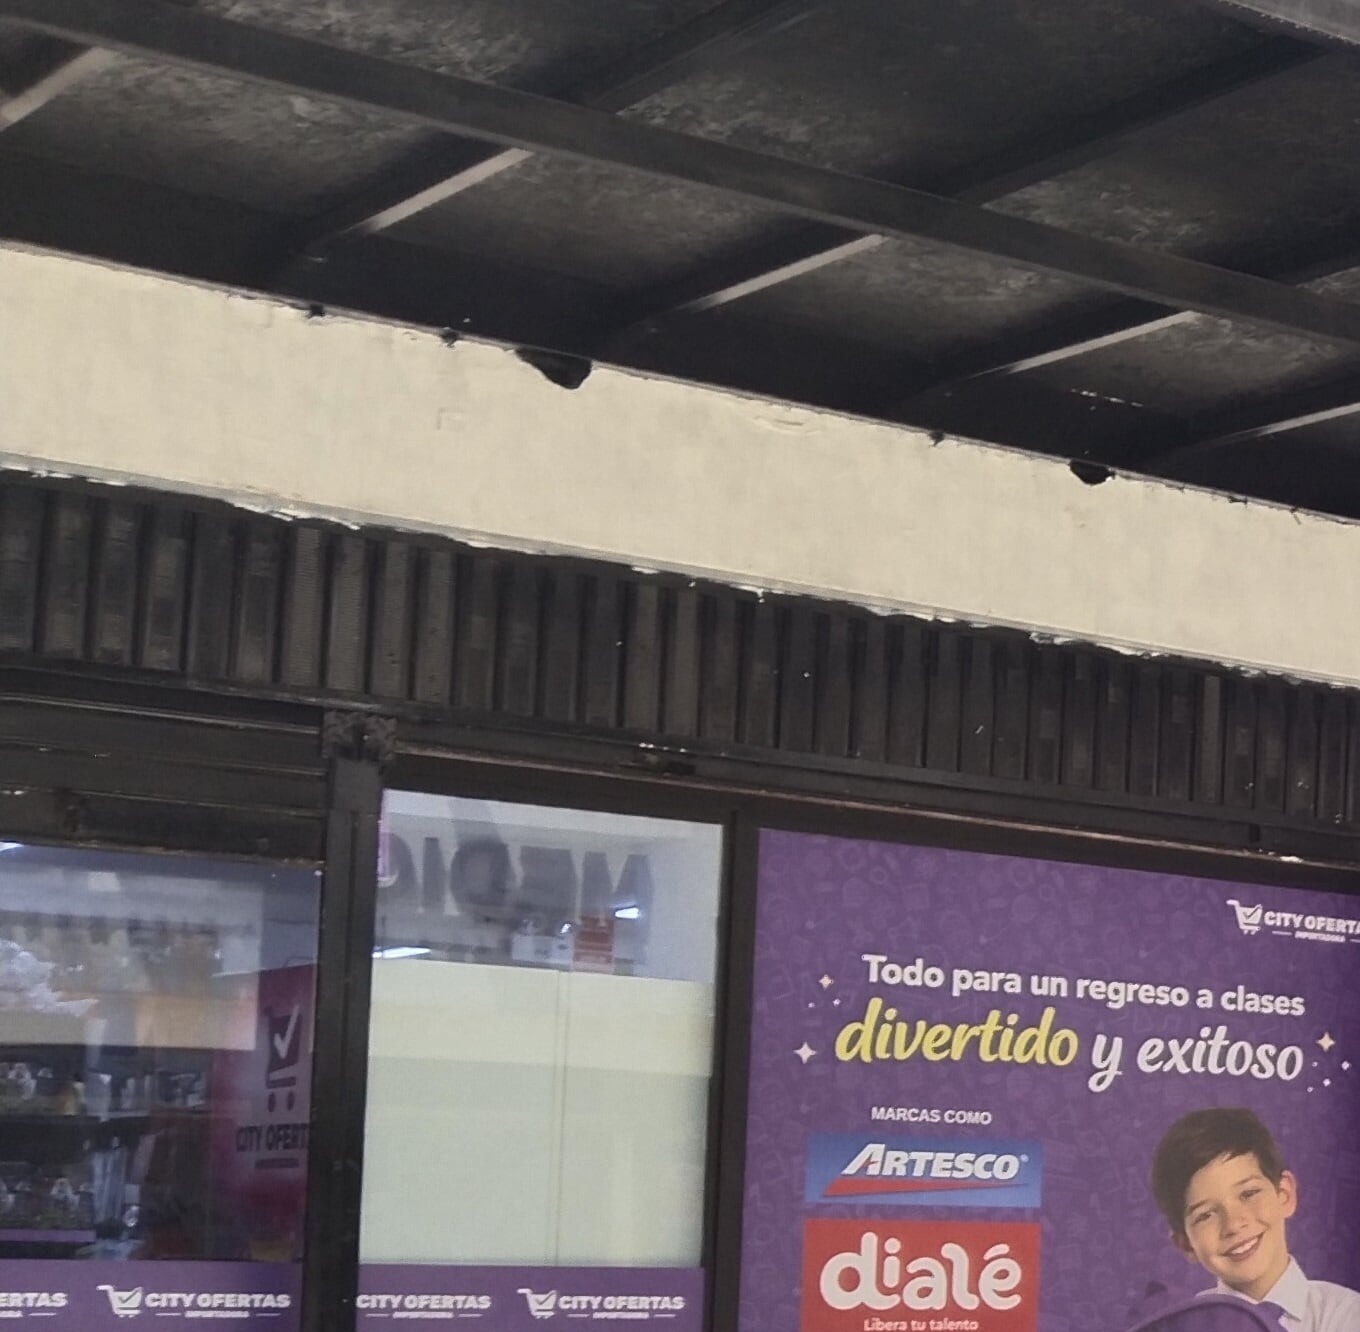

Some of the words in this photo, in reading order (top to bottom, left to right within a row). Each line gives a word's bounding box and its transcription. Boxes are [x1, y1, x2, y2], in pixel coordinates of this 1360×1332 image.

[1264, 911, 1304, 928] CITY
[861, 954, 944, 987] Todo
[952, 967, 1022, 996] para
[1031, 975, 1068, 997] un
[1076, 976, 1189, 1010] regreso
[1196, 990, 1213, 1008] a
[1221, 985, 1305, 1015] clases
[834, 997, 1079, 1065] divertido
[1088, 1033, 1124, 1092] y
[1136, 1025, 1304, 1081] exitoso
[871, 1107, 940, 1124] MARCAS
[943, 1109, 992, 1125] COMO
[840, 1143, 1020, 1180] ARTESCO
[819, 1231, 1023, 1311] dialé
[144, 1293, 196, 1308] CITY
[196, 1293, 291, 1308] OFERTAS
[356, 1294, 404, 1309] CITY
[403, 1294, 492, 1309] OFERTAS
[558, 1295, 603, 1310] CITY
[602, 1296, 686, 1310] OFERTAS
[864, 1317, 908, 1331] Libera
[911, 1318, 927, 1331] tu
[929, 1317, 979, 1331] talento
